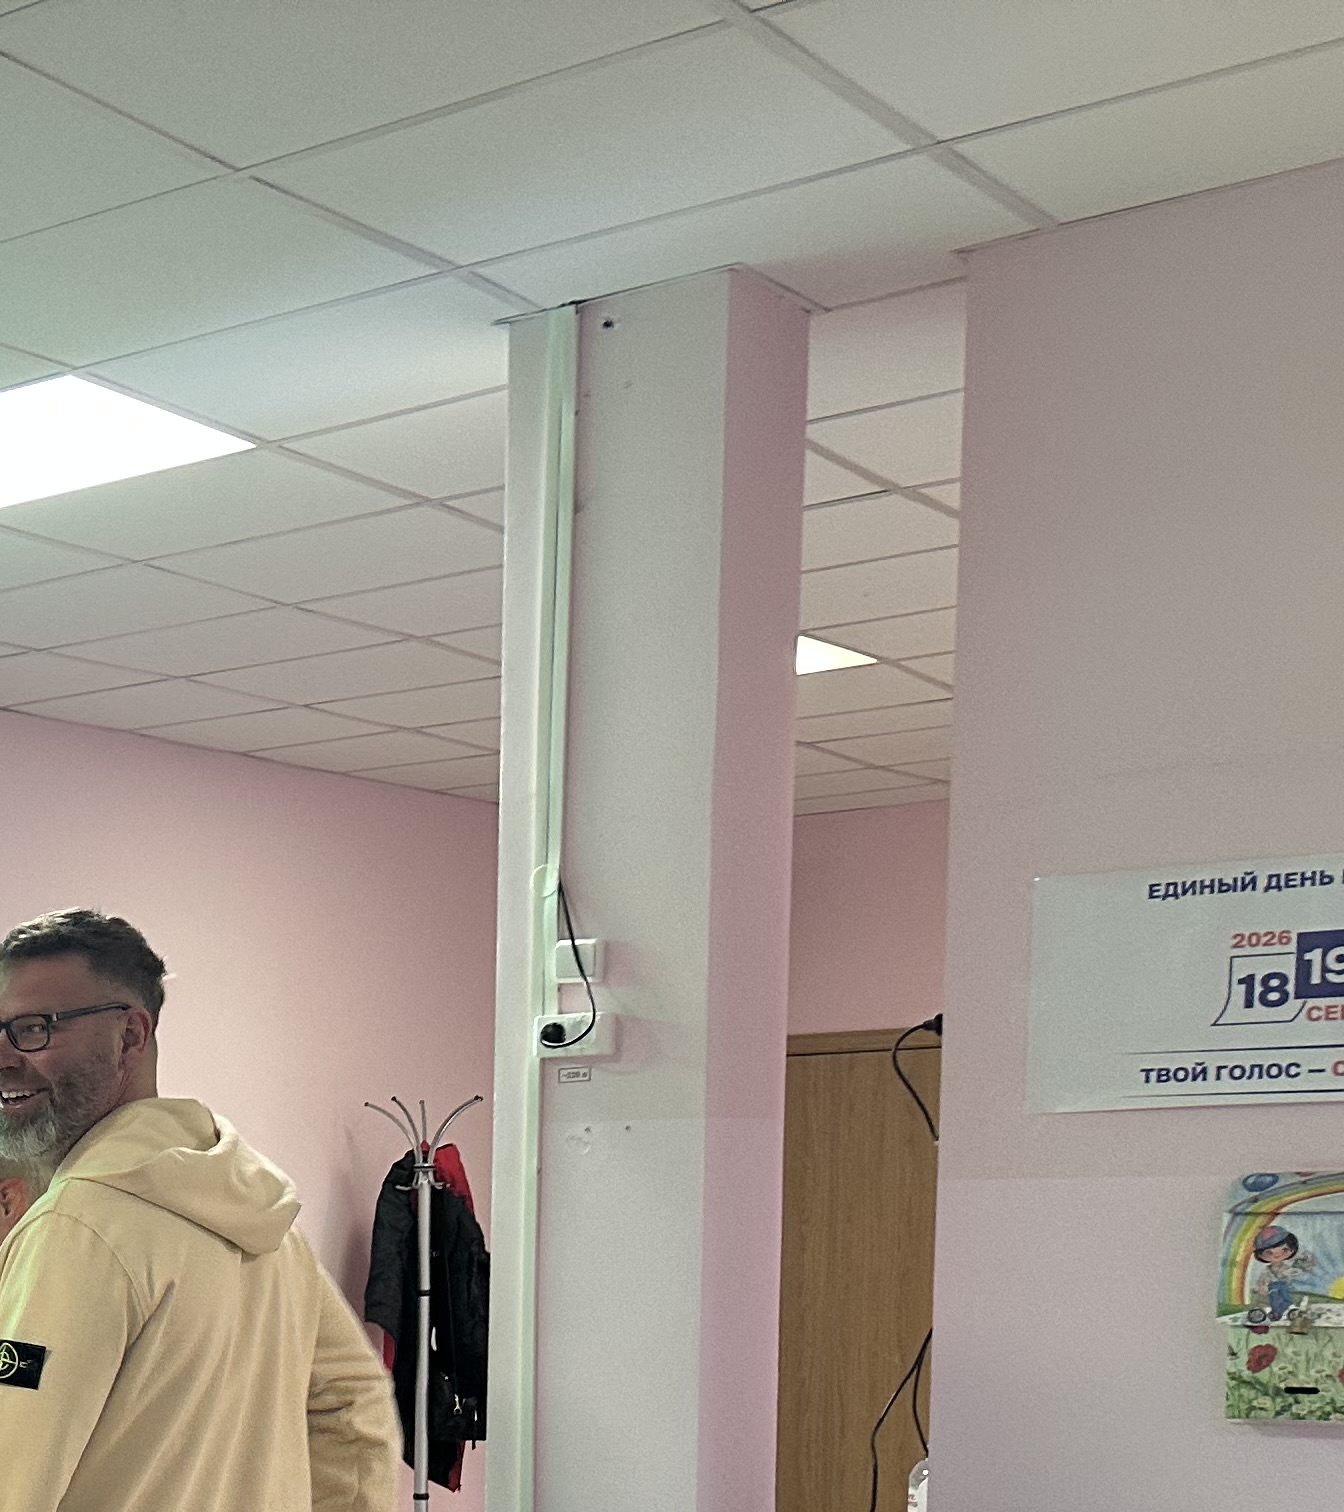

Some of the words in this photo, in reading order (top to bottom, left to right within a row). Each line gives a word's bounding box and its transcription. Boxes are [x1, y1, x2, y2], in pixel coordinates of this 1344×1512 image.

[1147, 871, 1258, 901] ЕДИНЫЙ
[1263, 869, 1335, 892] ДЕНЬ
[1231, 929, 1292, 950] 2026
[1237, 972, 1291, 1010] 18
[1140, 1062, 1208, 1084] ТВОЙ
[1215, 1061, 1302, 1081] ГОЛОС
